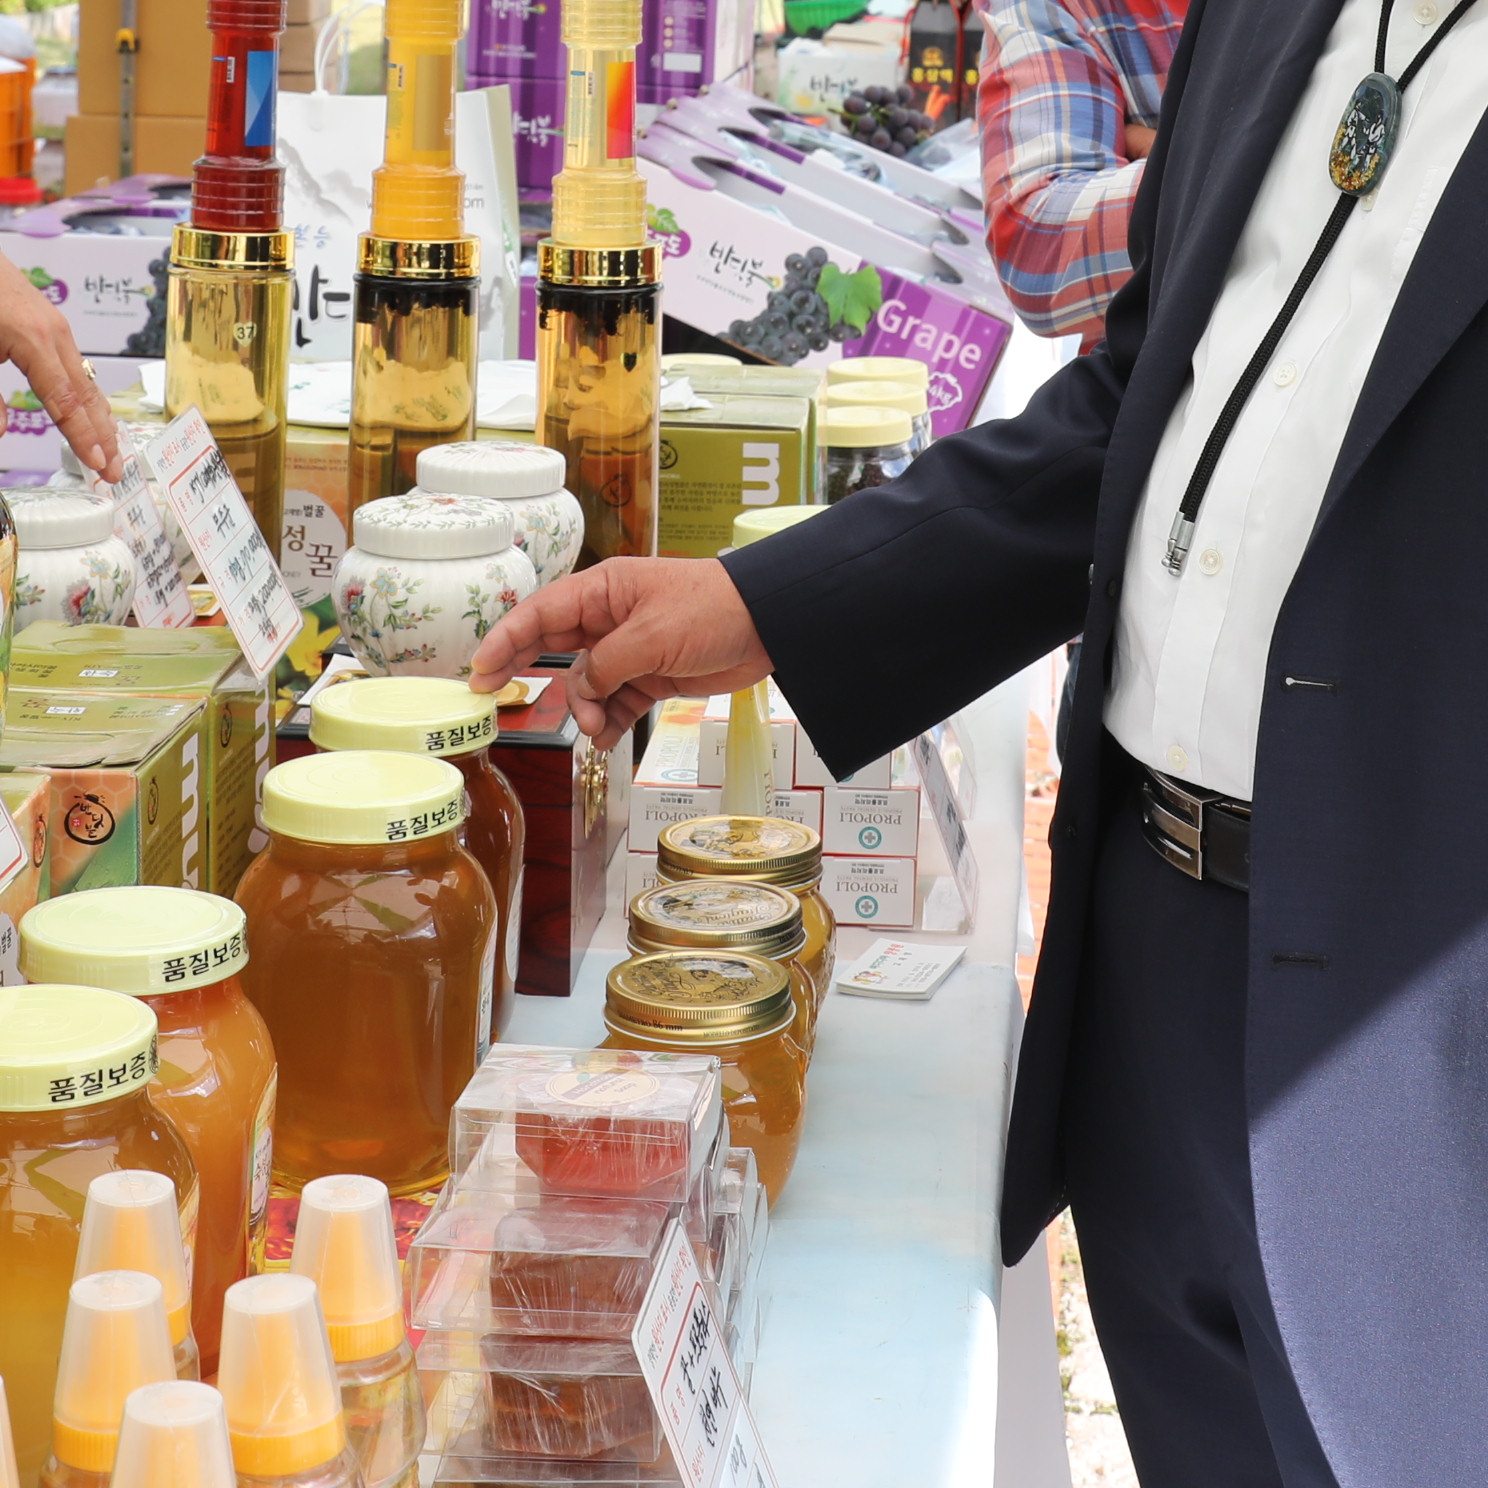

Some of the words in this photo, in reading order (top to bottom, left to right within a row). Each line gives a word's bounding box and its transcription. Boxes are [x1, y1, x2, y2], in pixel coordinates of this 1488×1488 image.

[236, 325, 254, 341] 37
[876, 298, 983, 370] Grape
[303, 504, 325, 518] 벌꿀
[425, 715, 492, 751] 품질보증
[385, 799, 458, 841] 품질보증
[840, 812, 903, 825] PROPOLI
[836, 883, 899, 895] PROPOLI
[1, 927, 12, 954] 벌꿀
[162, 932, 242, 983] 품질보증
[652, 1019, 664, 1031] 86
[664, 1023, 684, 1032] mm
[48, 1051, 147, 1103] 품질보증
